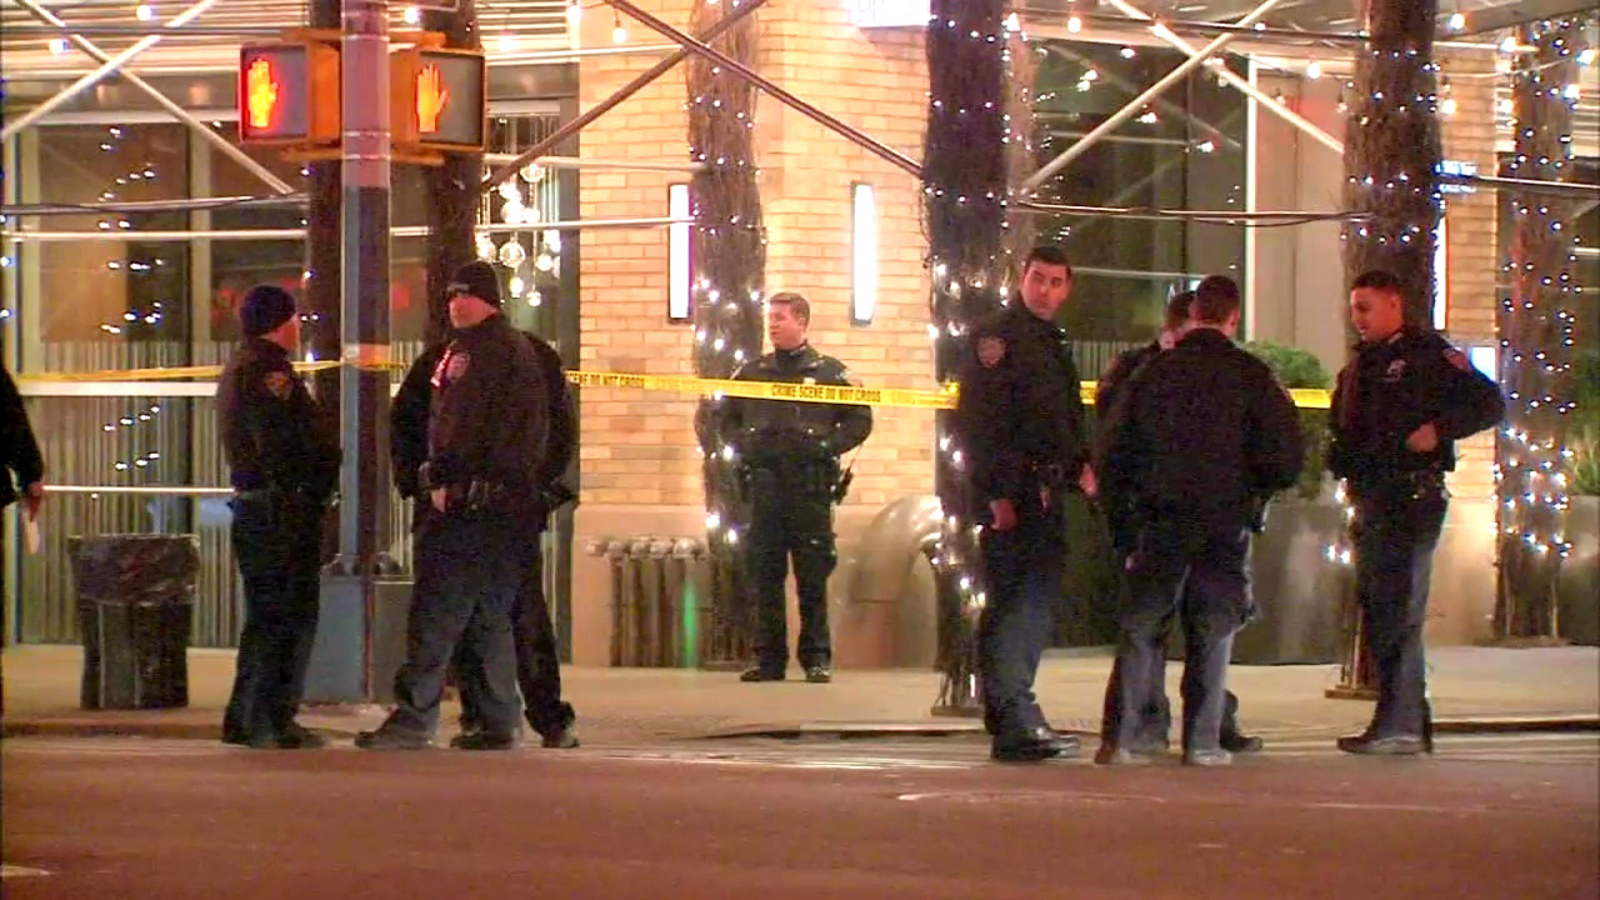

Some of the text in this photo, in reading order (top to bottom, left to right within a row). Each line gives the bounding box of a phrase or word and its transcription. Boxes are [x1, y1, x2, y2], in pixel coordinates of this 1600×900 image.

[771, 384, 797, 396] CRIME
[799, 385, 824, 399] SCENE
[856, 389, 881, 403] CROSS
